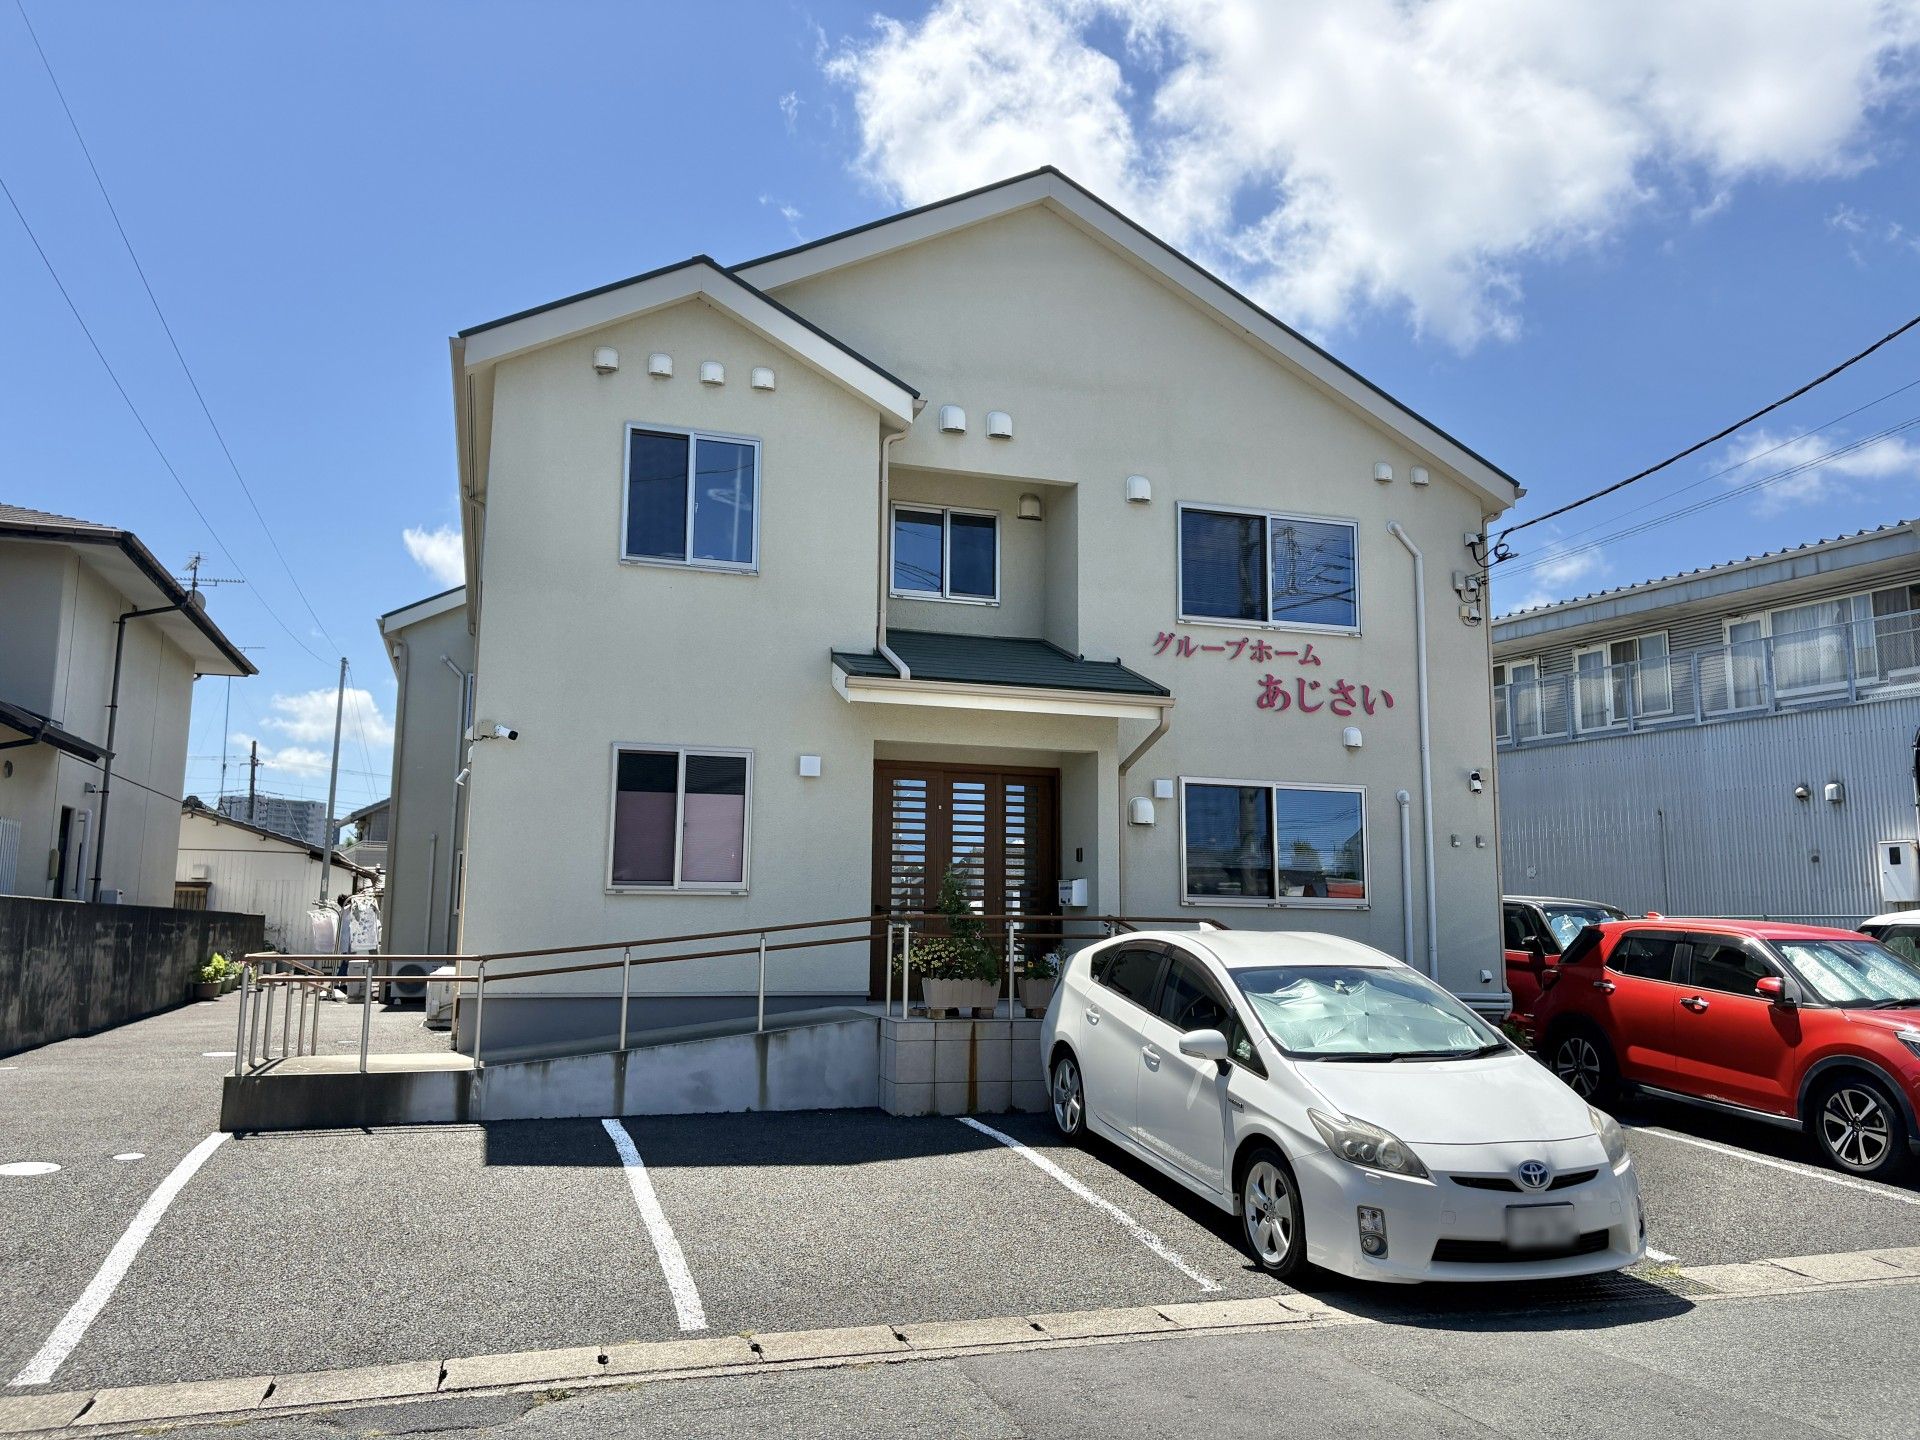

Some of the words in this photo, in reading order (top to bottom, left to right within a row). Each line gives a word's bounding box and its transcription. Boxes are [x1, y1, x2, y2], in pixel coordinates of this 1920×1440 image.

[1153, 631, 1322, 667] グループホーム
[1256, 673, 1395, 717] あじさい
